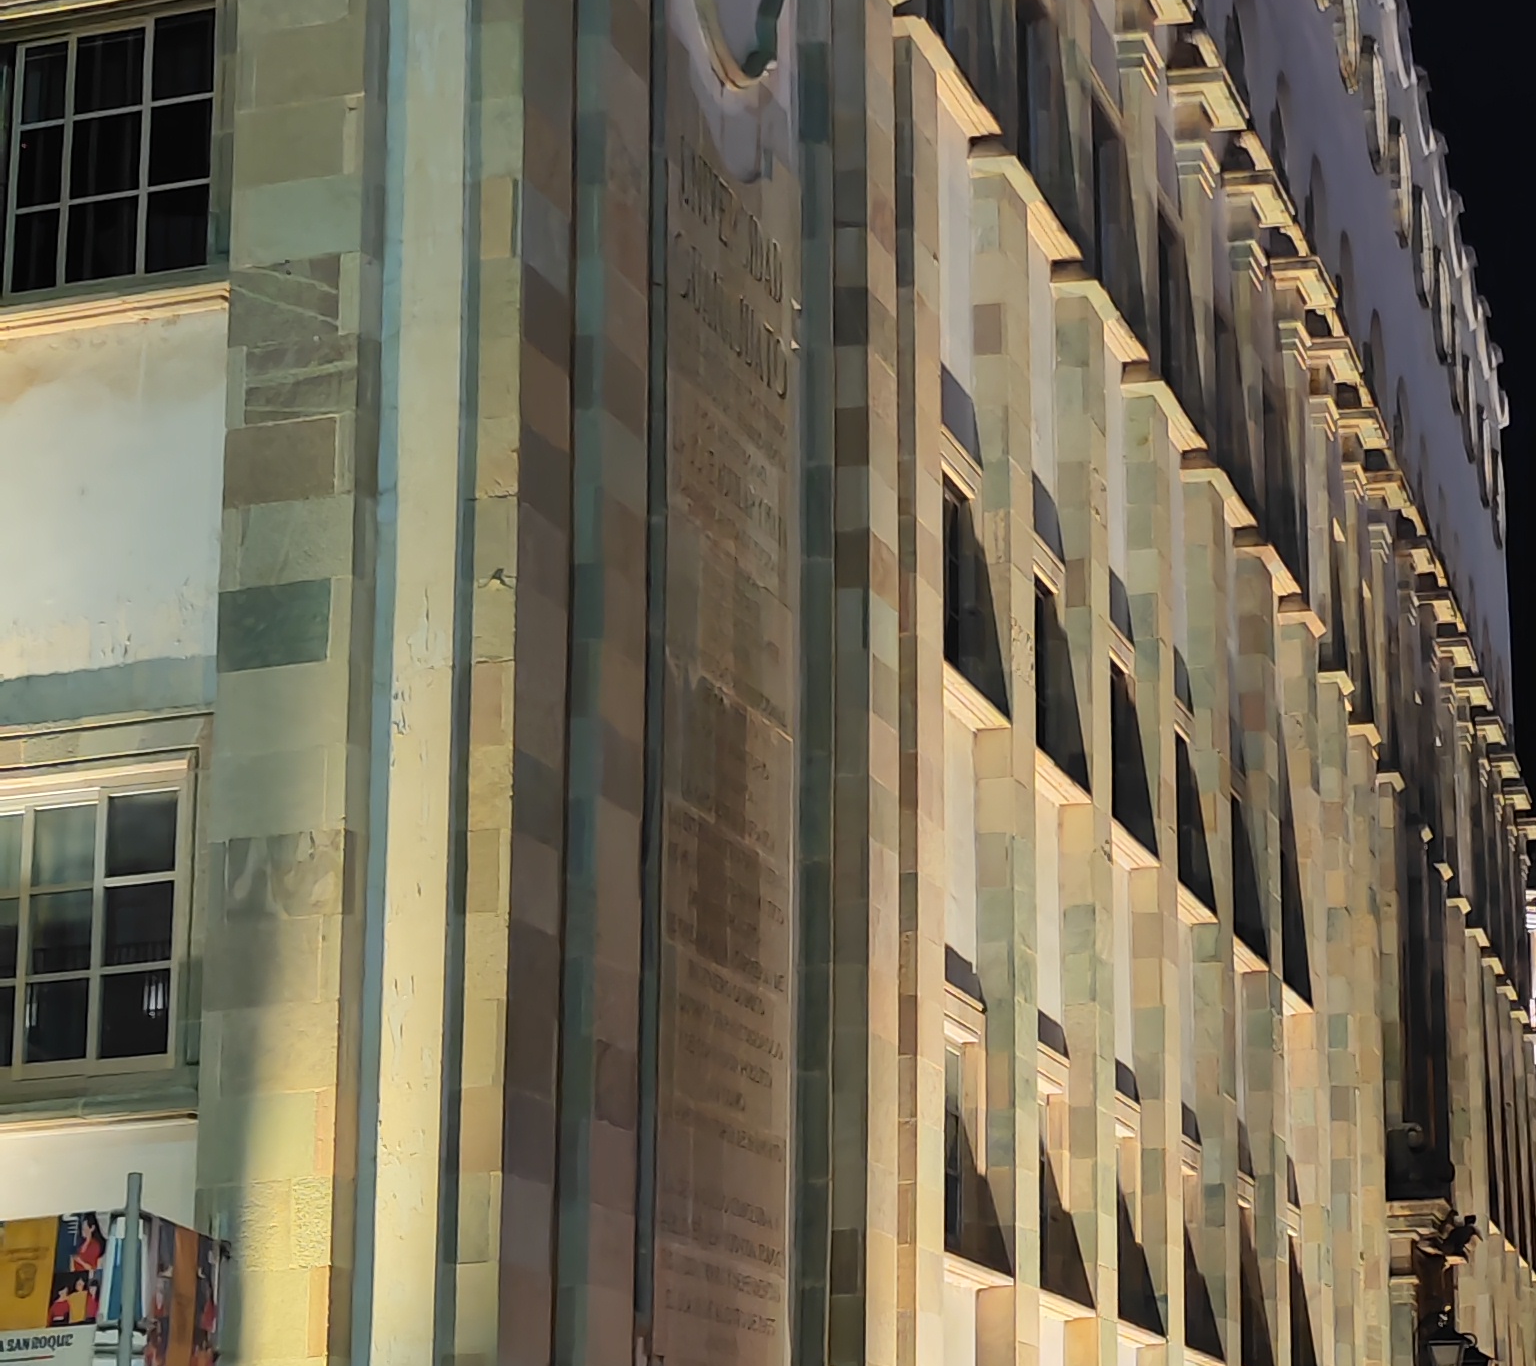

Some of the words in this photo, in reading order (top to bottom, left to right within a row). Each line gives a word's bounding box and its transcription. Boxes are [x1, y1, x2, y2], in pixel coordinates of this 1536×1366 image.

[680, 134, 784, 303] UNIVEIDAD
[6, 1337, 31, 1352] SAN
[31, 1333, 74, 1352] ROQUE
